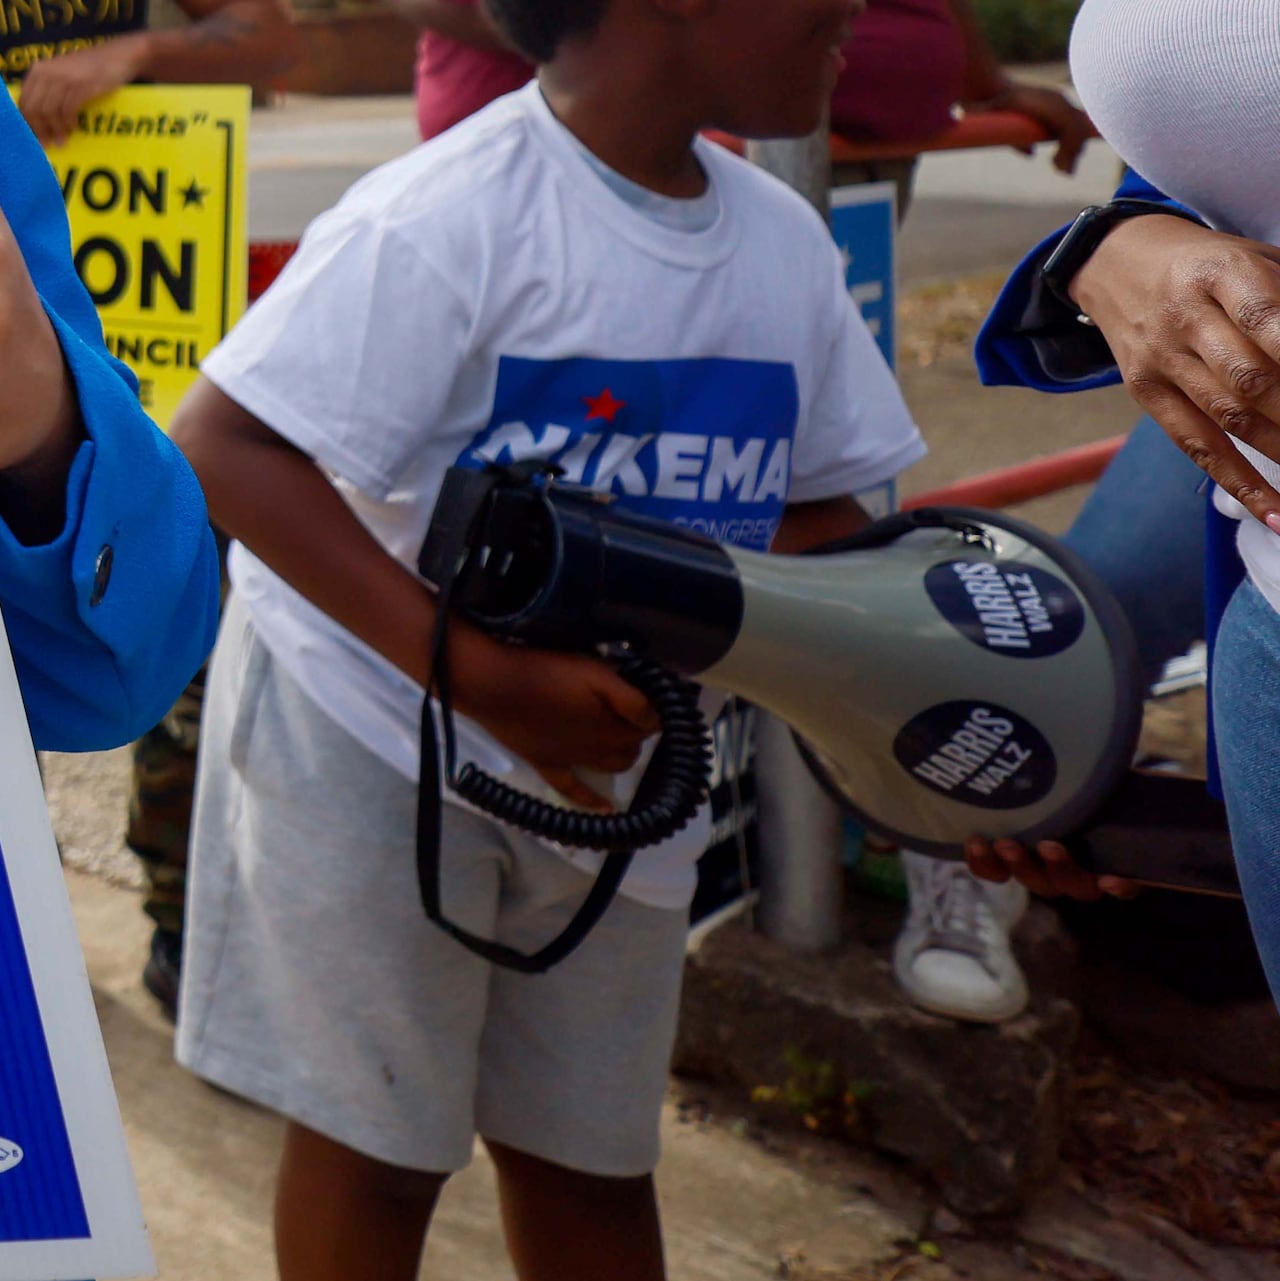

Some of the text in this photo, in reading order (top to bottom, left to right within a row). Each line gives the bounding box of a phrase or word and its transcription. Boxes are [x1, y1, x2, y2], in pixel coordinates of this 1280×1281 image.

[953, 561, 1031, 648] HARRIS
[1006, 572, 1053, 634] WALZ
[913, 707, 1015, 791] HARRIS
[967, 741, 1032, 796] WALZ
